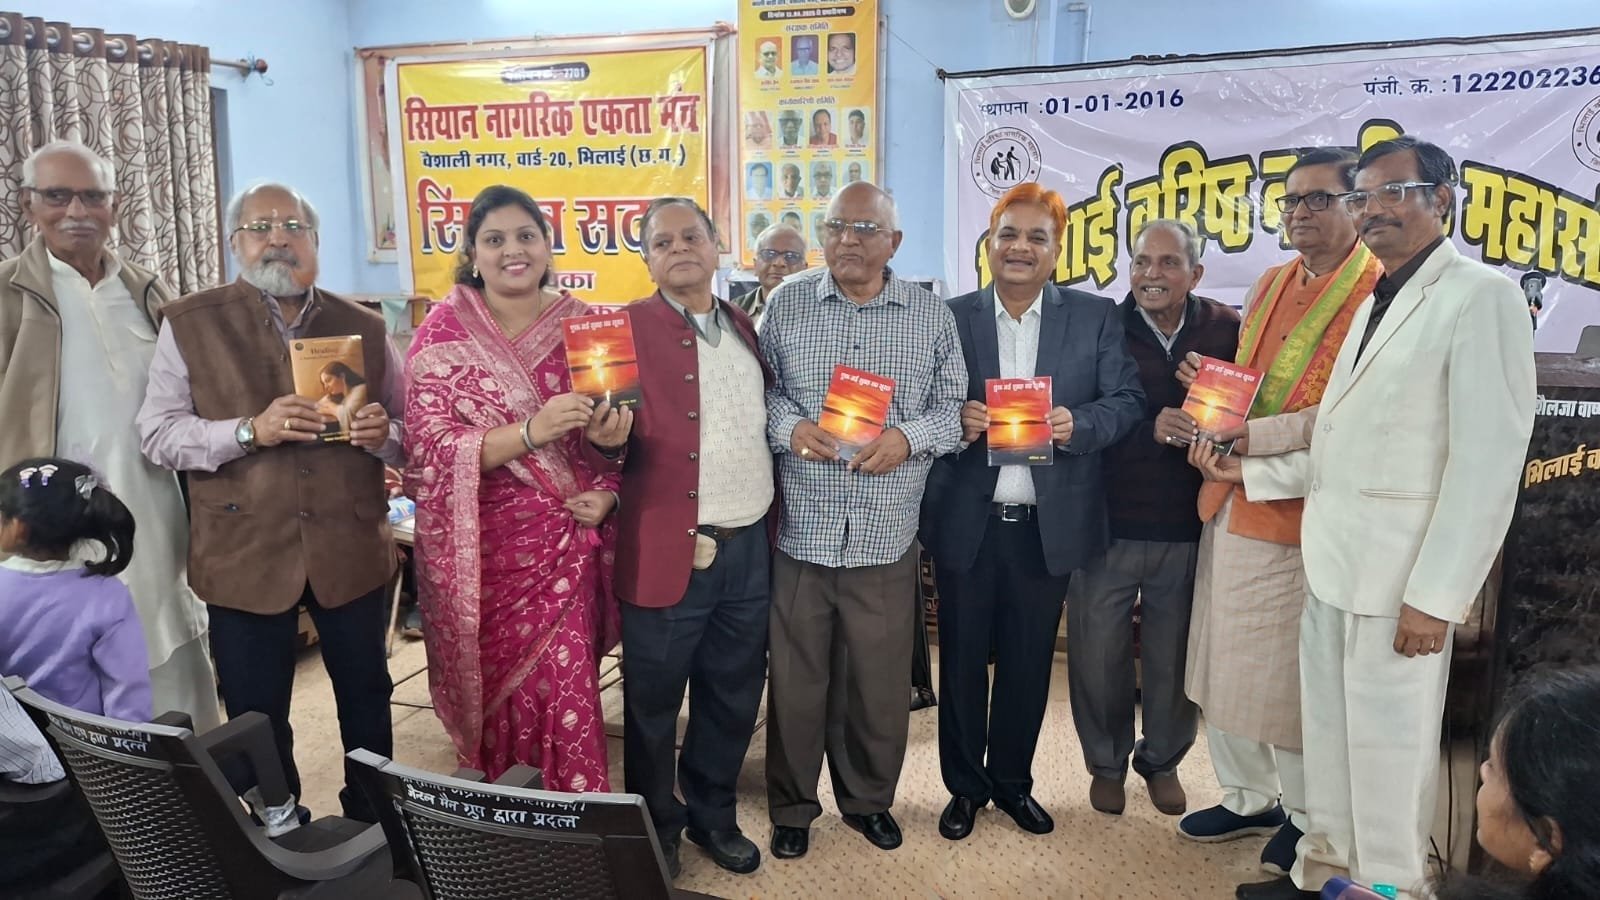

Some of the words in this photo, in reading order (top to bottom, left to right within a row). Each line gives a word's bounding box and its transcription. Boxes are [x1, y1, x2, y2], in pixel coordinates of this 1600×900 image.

[405, 97, 479, 141] सियान
[483, 92, 575, 138] नागरिक
[580, 98, 652, 136] एकता
[422, 151, 470, 168] वैशाली
[475, 152, 511, 169] नगर,
[577, 146, 626, 165] भिलाई
[1524, 444, 1586, 488] भिलाई
